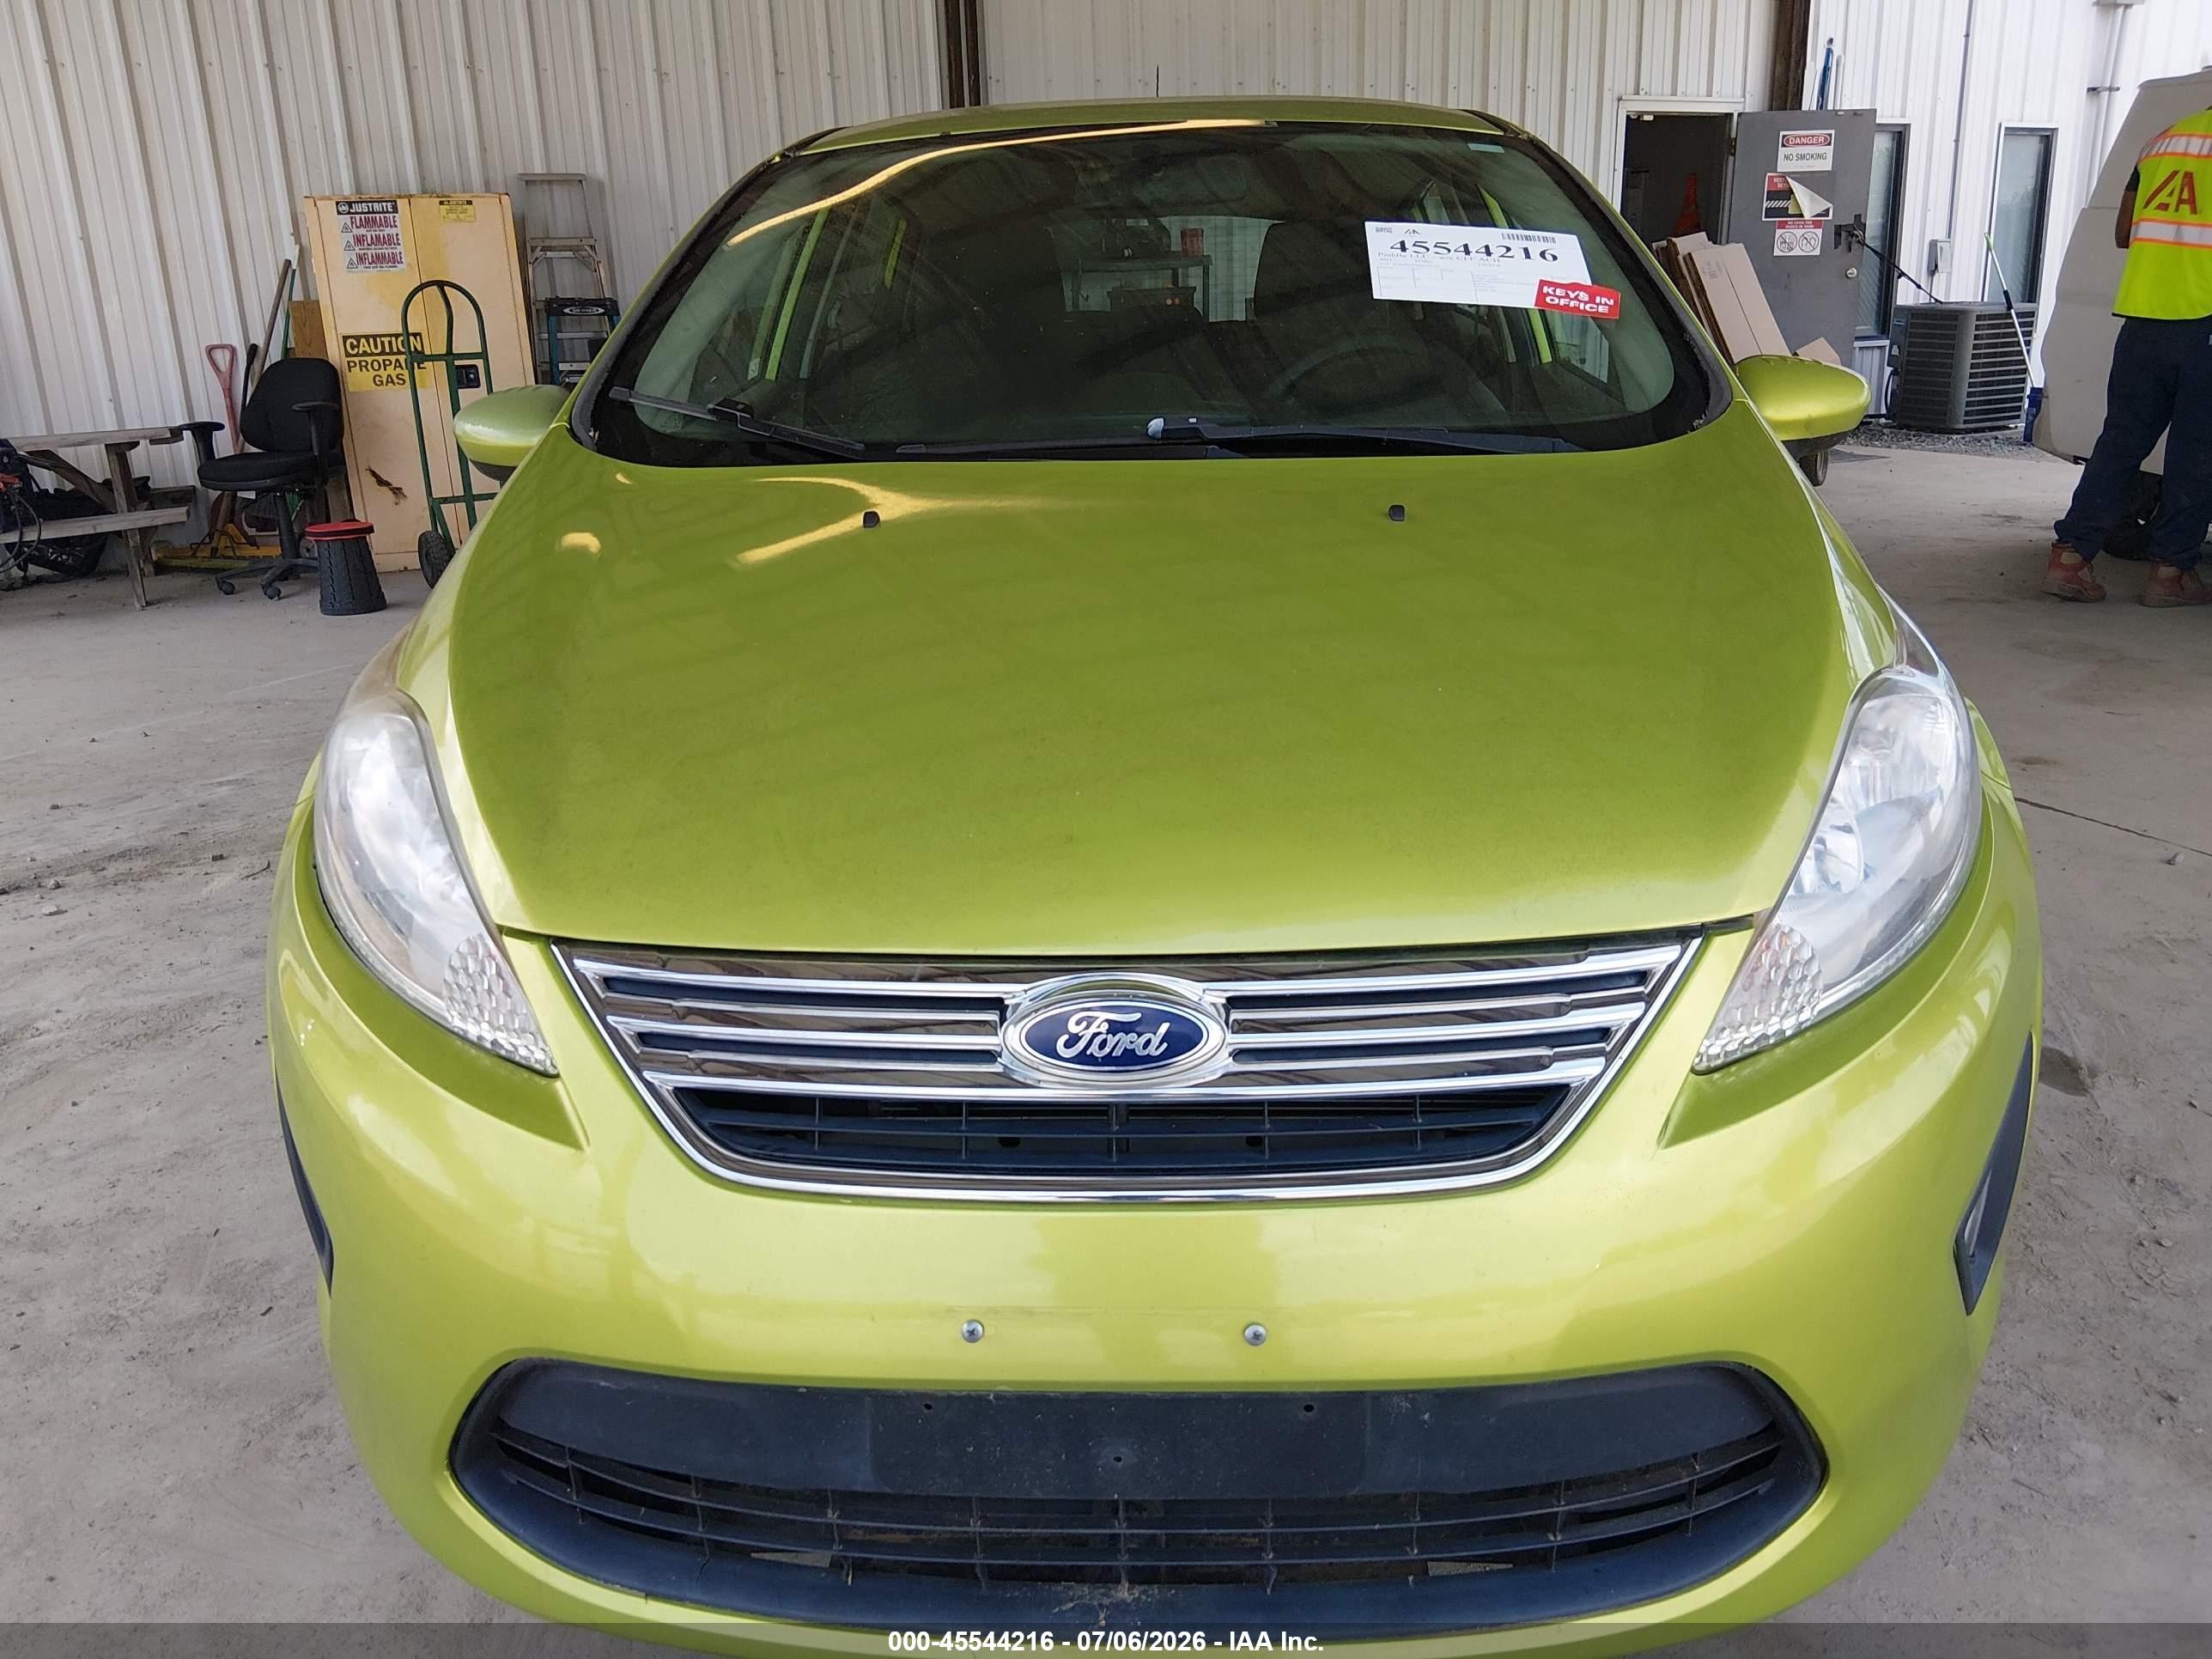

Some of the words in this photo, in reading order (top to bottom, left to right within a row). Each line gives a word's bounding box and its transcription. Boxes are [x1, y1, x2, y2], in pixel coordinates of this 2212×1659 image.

[1789, 136, 1825, 144] DANGER
[1784, 153, 1794, 162] NO
[1796, 152, 1827, 161] SMOKING
[349, 202, 393, 212] JUSTRITE
[349, 215, 398, 229] FLAMMABLE
[353, 233, 401, 247] INFLAMABLE
[356, 251, 404, 265] INFLAMMABLE
[1389, 240, 1559, 262] 45544216
[1542, 285, 1589, 301] KEYS
[1595, 295, 1614, 306] IN
[1545, 296, 1609, 313] OFFICE
[347, 357, 427, 373] PROPAE
[373, 373, 406, 386] GAS
[1056, 1011, 1170, 1058] Ford
